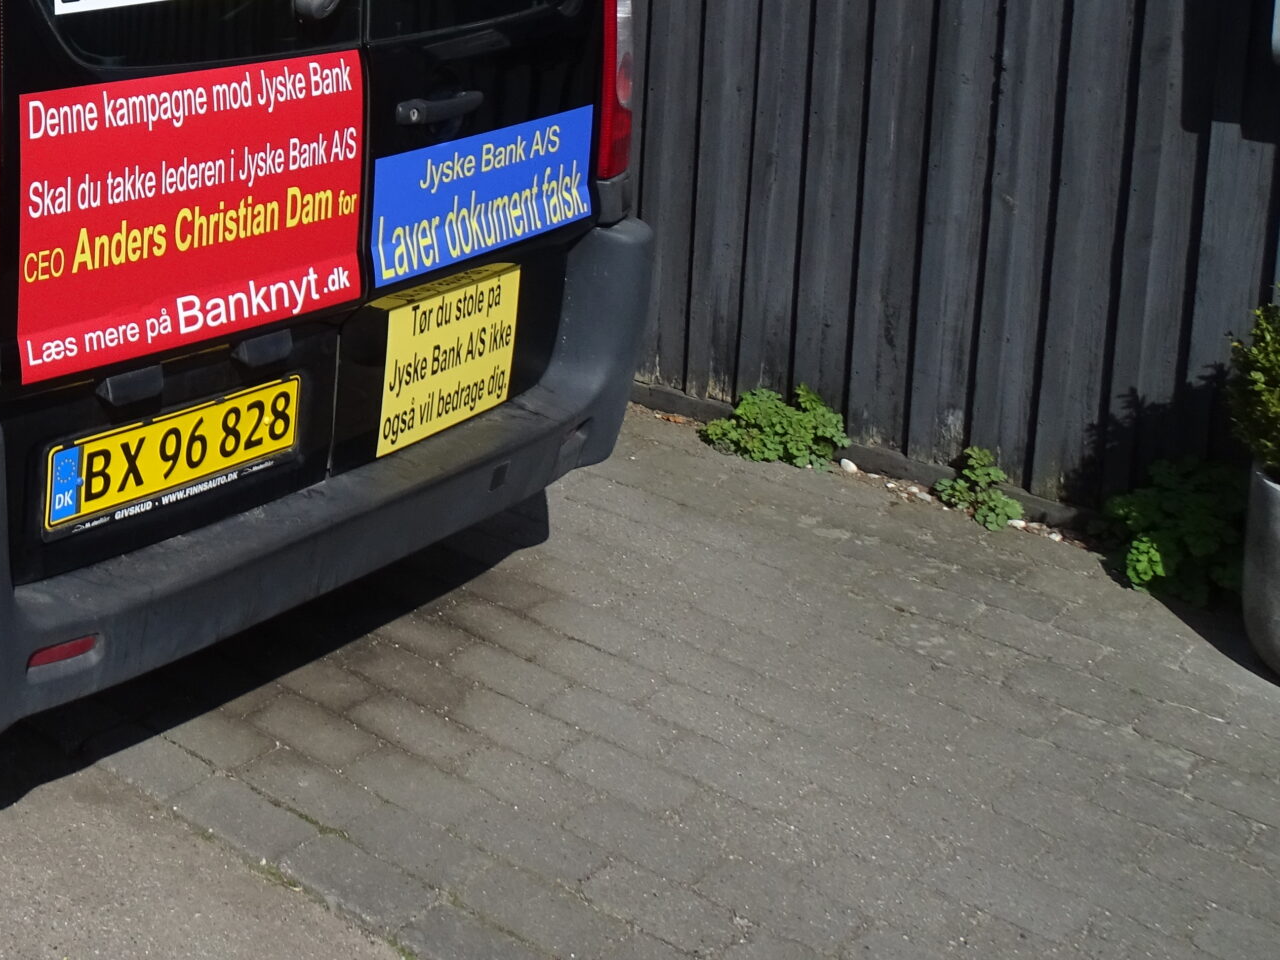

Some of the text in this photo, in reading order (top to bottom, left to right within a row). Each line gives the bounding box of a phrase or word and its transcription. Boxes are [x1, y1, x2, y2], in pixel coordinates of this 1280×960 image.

[28, 58, 352, 139] Denne kampagne mod Jyske Bank
[28, 126, 356, 218] Skal du takke lederen i Jyske Bank A/S
[419, 125, 559, 193] Jyske Bank A/S
[24, 186, 357, 282] CEO Anders Christian Dam for
[378, 159, 587, 280] Laver dokument falsk.
[26, 336, 77, 365] Læs
[84, 322, 139, 352] mere
[145, 307, 172, 343] på
[410, 296, 436, 336] Tør
[435, 290, 455, 328] du
[455, 284, 484, 320] stole
[486, 274, 501, 317] på
[388, 320, 511, 397] Jyske Bank A/S ikke
[382, 364, 506, 445] også vil bedrage dig.
[83, 391, 291, 503] BX 96 828
[55, 490, 73, 510] DK
[114, 470, 239, 520] GIVSKUD WWW.FINNSAUTO.DK
